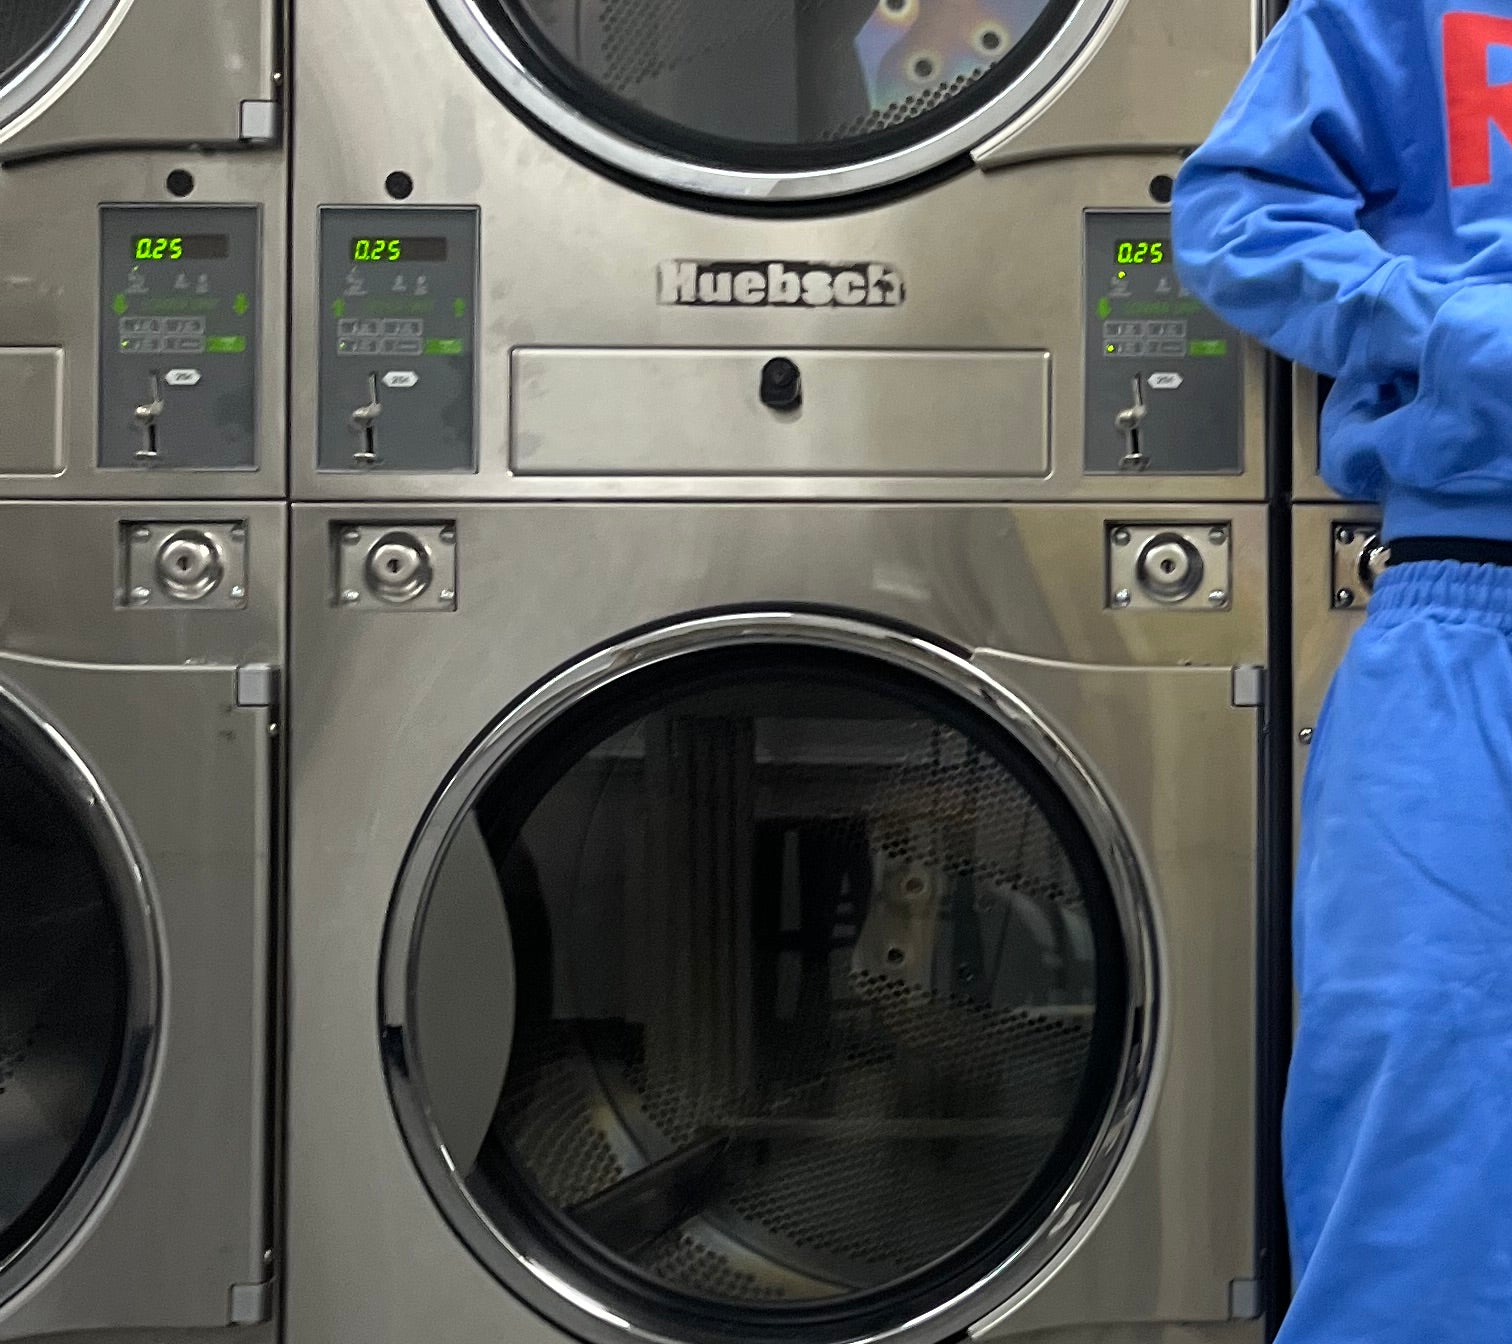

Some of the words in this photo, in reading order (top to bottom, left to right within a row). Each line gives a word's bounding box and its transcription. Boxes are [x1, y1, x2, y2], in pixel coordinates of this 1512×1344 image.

[136, 238, 183, 259] 0.25
[355, 240, 401, 261] 0.25
[1117, 242, 1163, 264] 0.25
[658, 261, 905, 306] Huebsch
